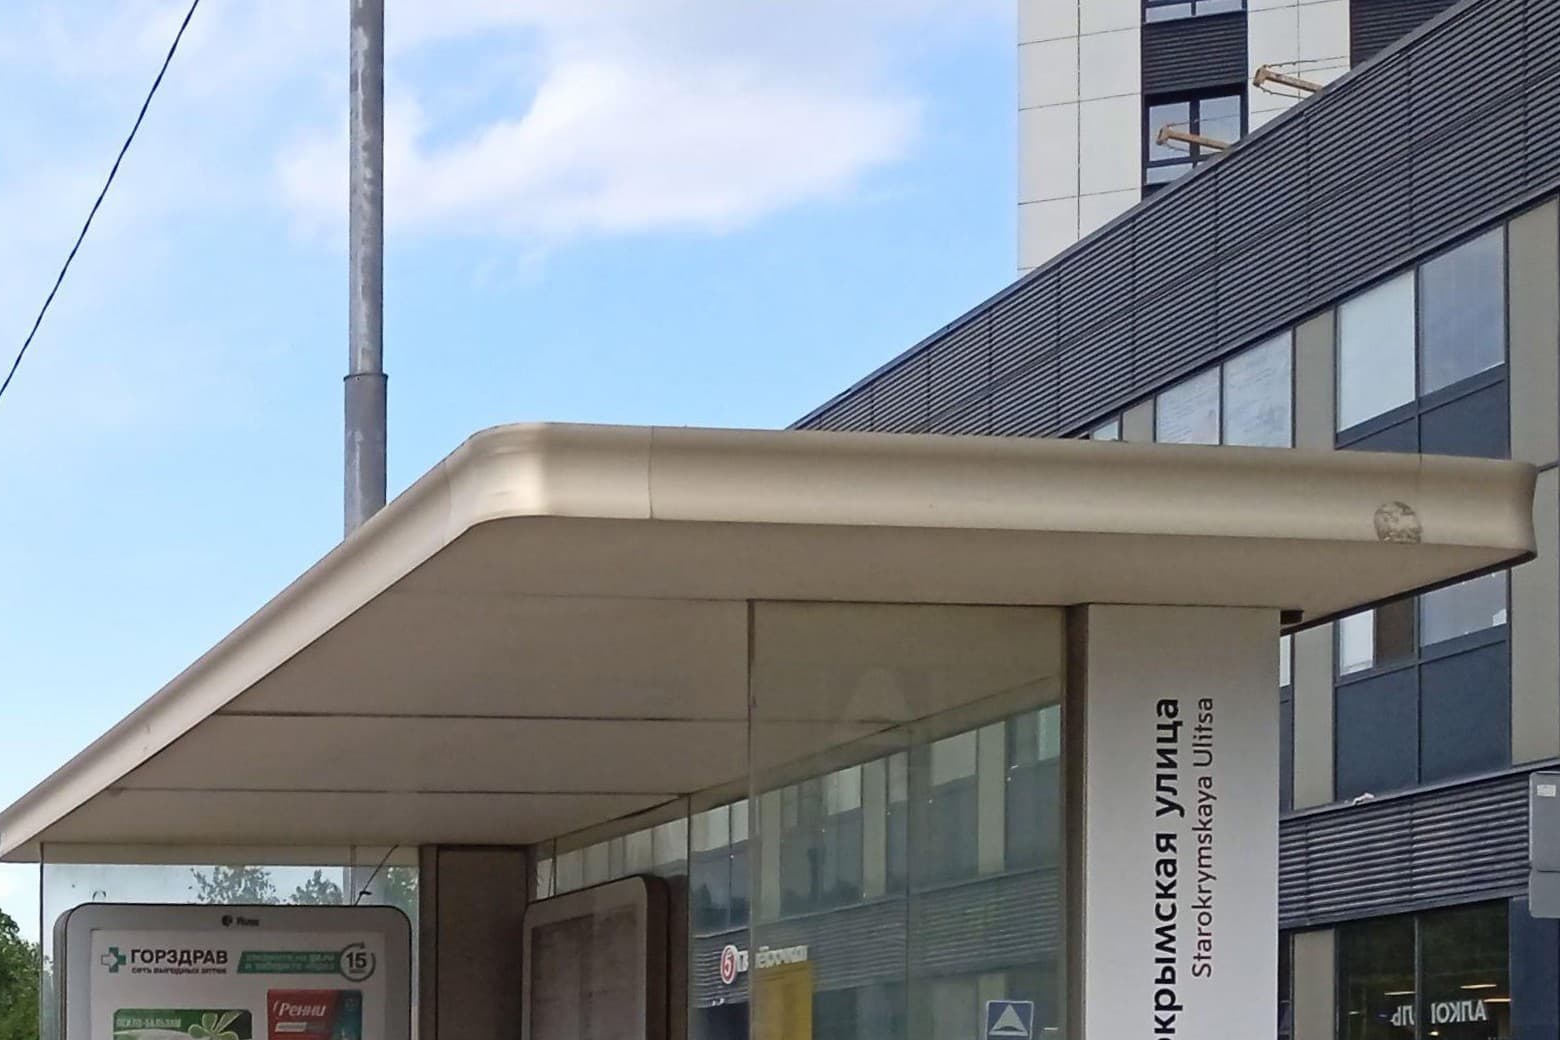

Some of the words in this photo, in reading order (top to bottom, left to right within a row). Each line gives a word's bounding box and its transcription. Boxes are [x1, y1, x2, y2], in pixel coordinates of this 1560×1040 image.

[1192, 697, 1214, 767] Ulitsa
[1155, 698, 1185, 818] улица
[1192, 776, 1217, 978] Starokrymskaya
[131, 949, 228, 966] ГОРЗДРАВ
[346, 952, 367, 969] 15
[279, 1002, 326, 1017] Ренни
